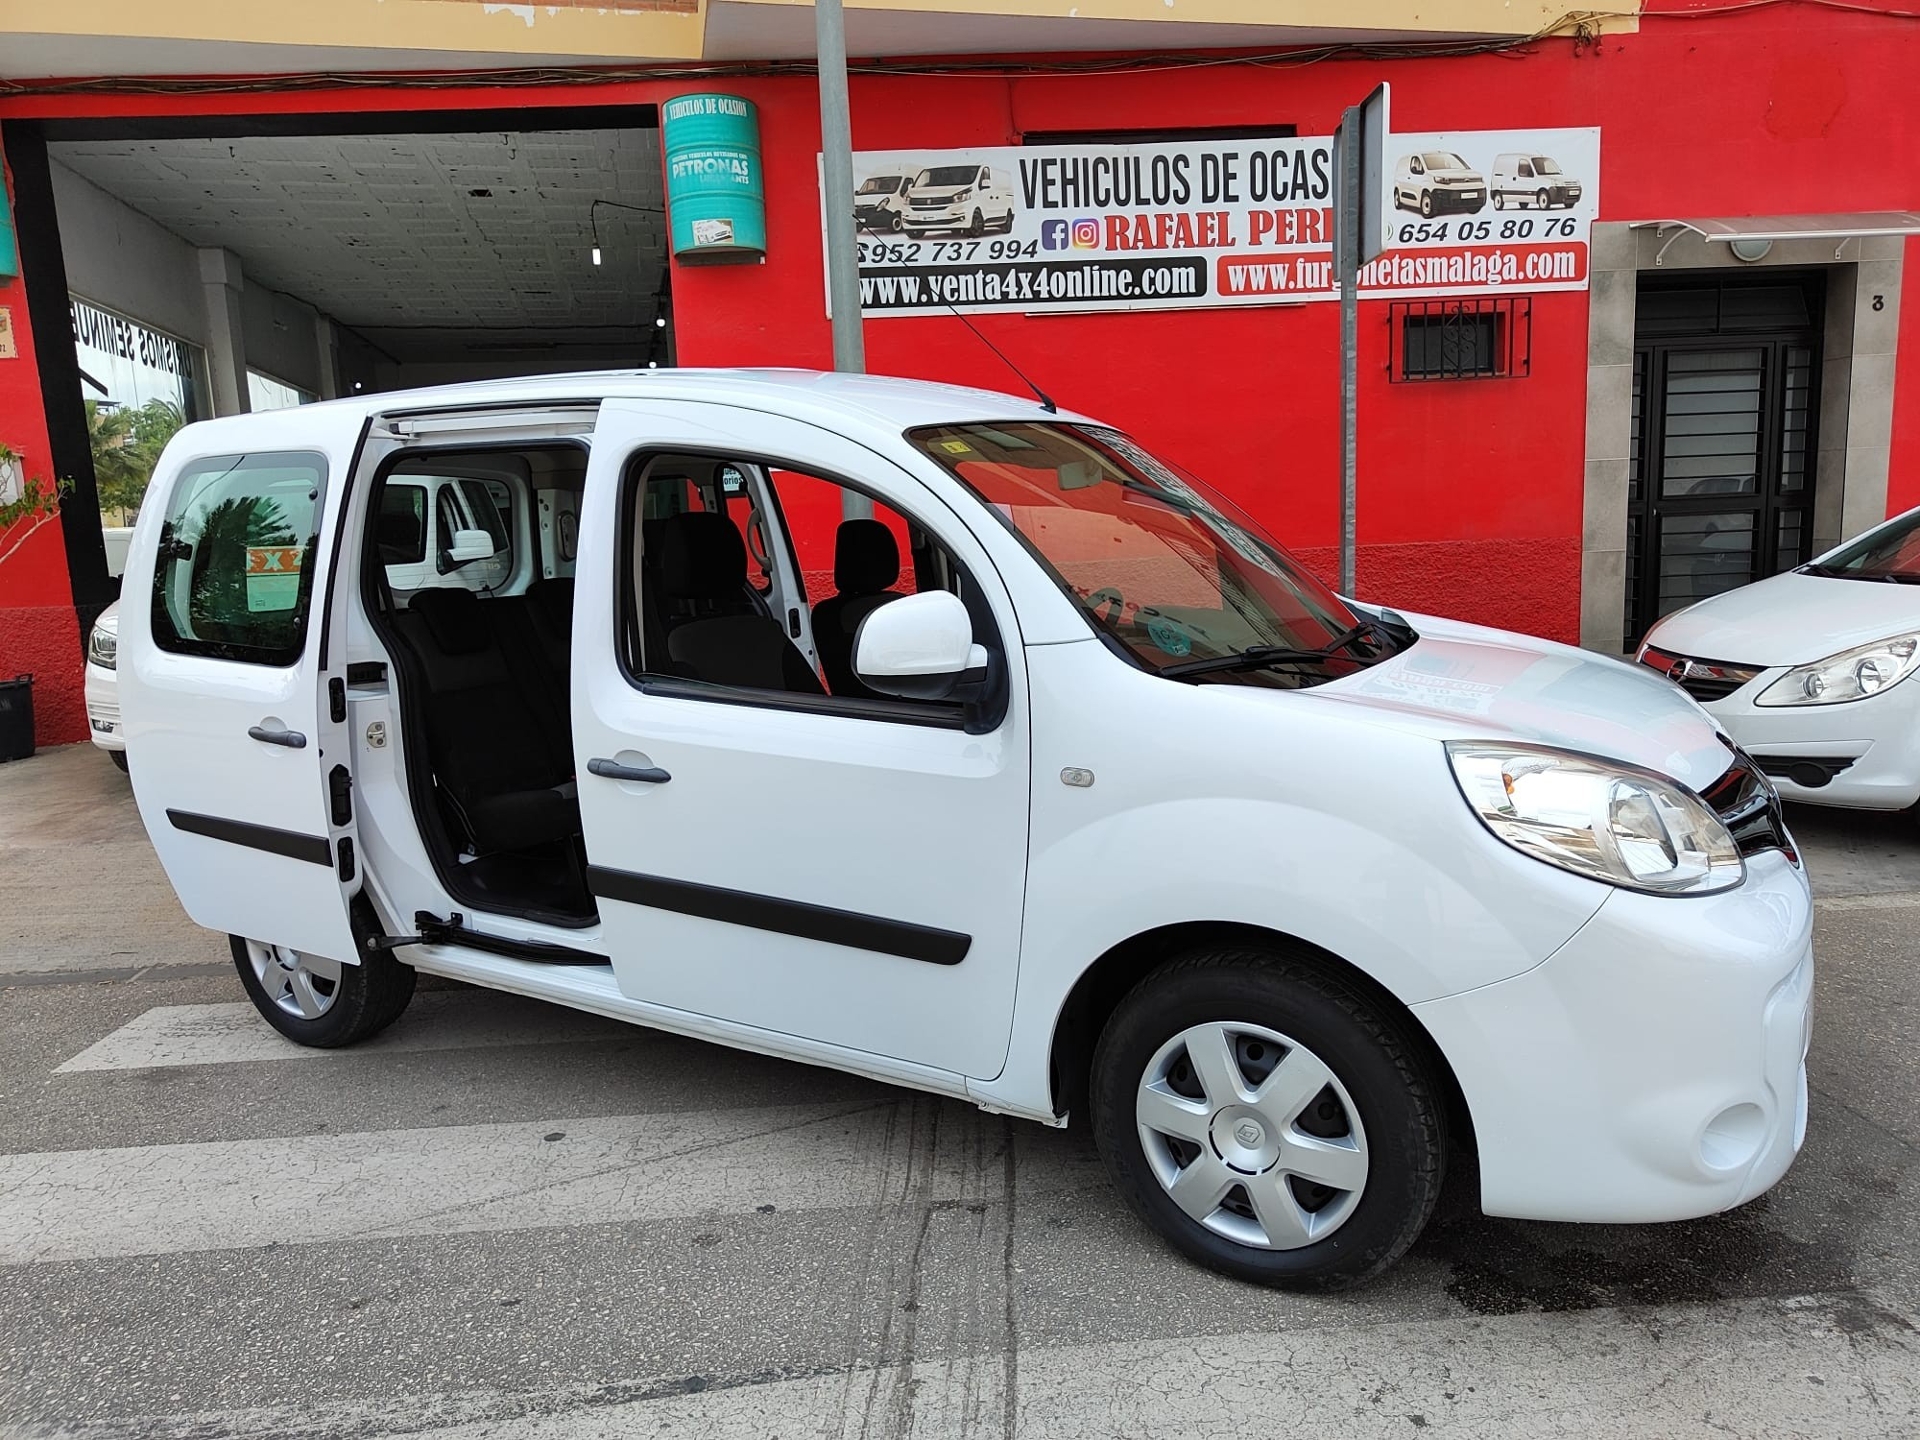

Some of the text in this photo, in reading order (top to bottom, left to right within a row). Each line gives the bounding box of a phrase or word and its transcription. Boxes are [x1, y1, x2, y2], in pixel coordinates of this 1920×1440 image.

[705, 98, 717, 114] DE
[672, 158, 749, 179] PETRONAS
[1019, 153, 1191, 209] VEHICULOS
[1201, 152, 1240, 203] DE
[1104, 211, 1236, 251] RAFAEL
[1398, 217, 1577, 244] 654 05 80 76
[870, 238, 1039, 264] 952 737 994
[859, 263, 1197, 304] www.venta4x4online.com
[1872, 294, 1885, 312] 3
